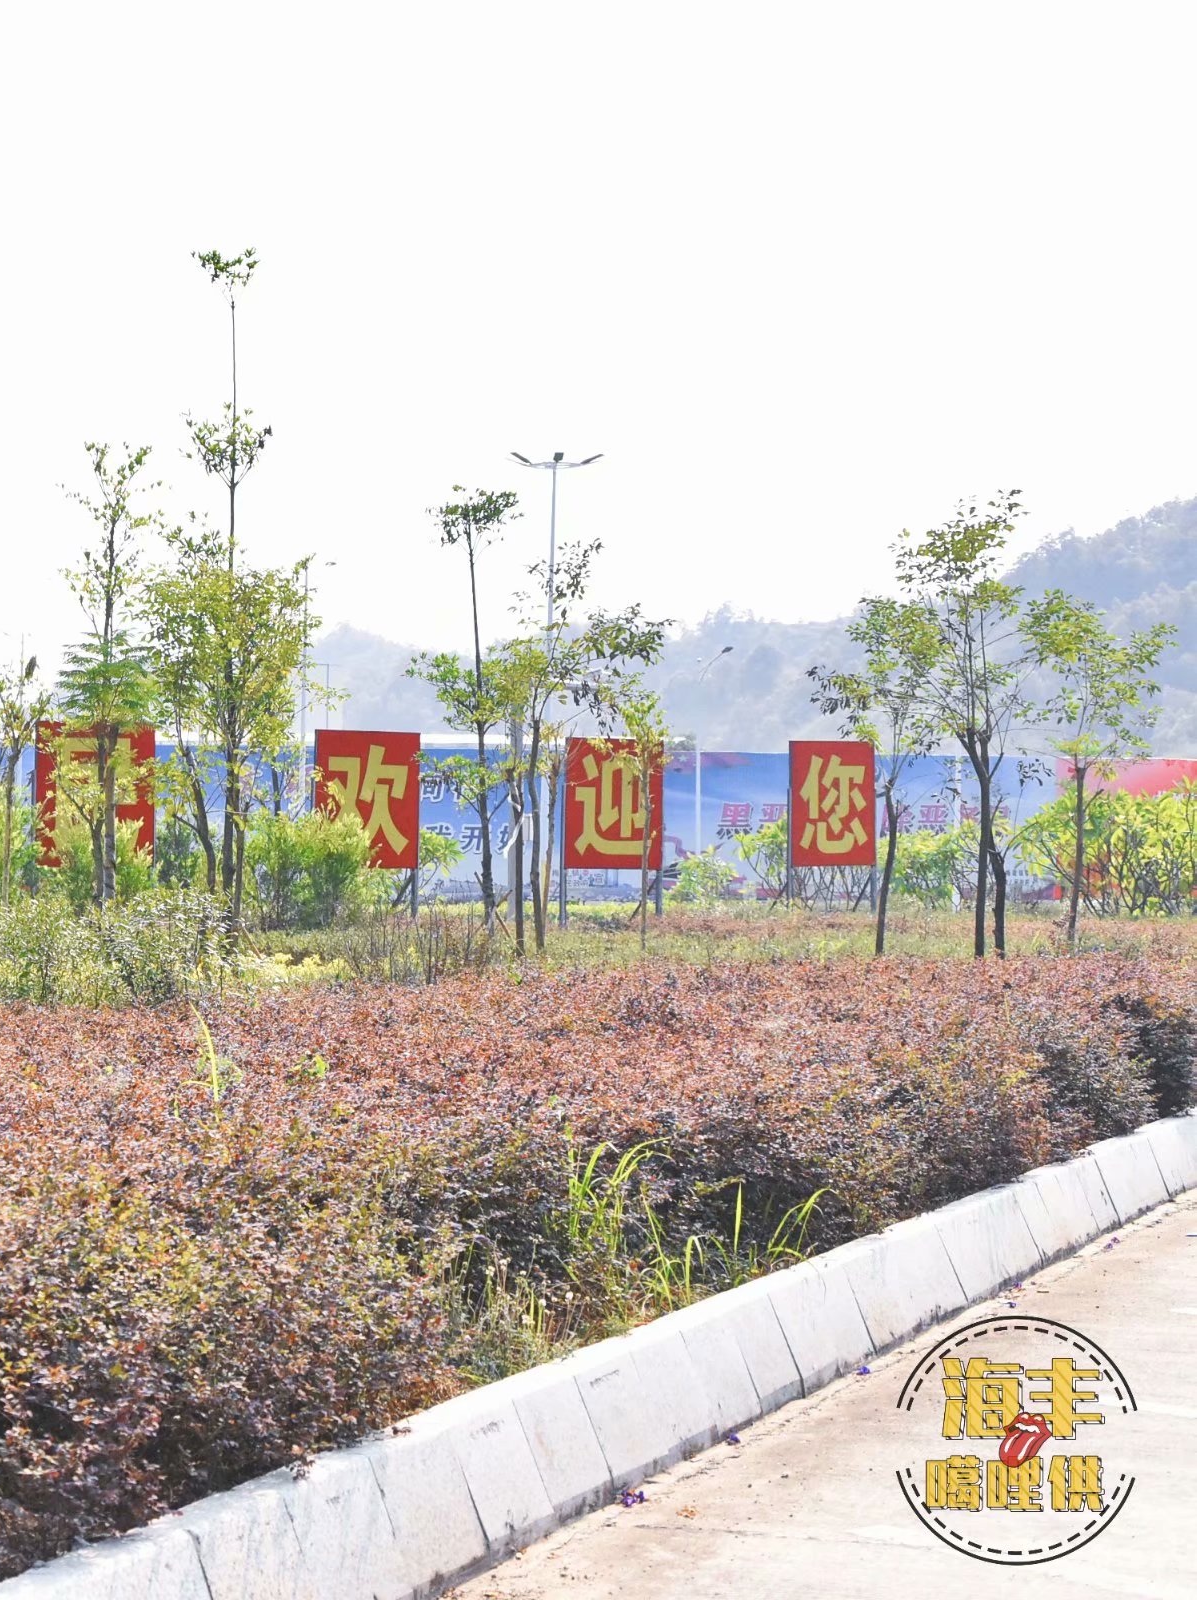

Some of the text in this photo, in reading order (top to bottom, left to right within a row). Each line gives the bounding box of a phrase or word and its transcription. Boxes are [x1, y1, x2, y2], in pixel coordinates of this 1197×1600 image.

[327, 744, 410, 856] 欢
[574, 753, 653, 857] 迎
[799, 753, 869, 854] 您
